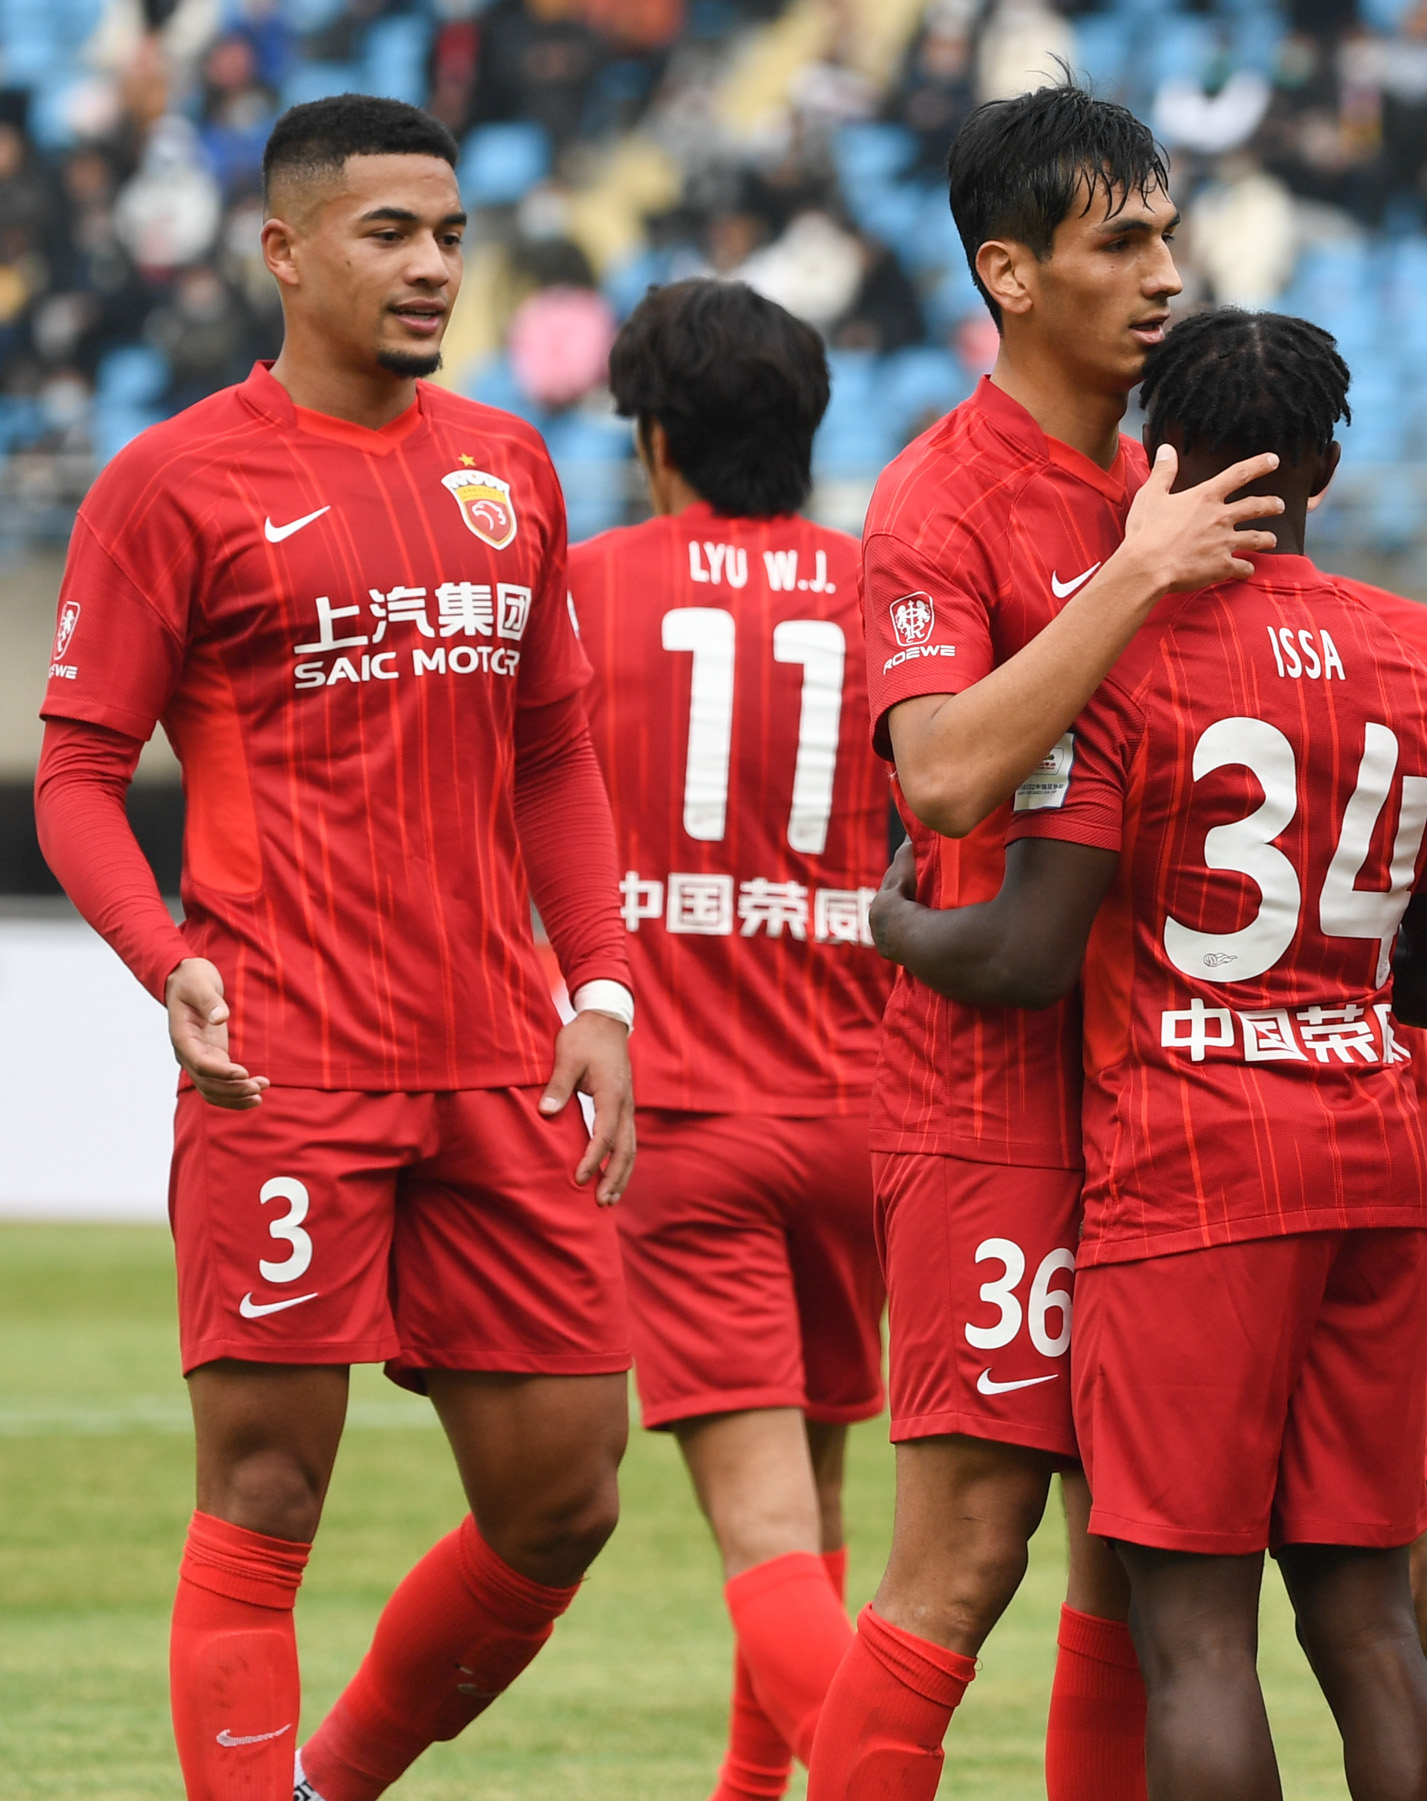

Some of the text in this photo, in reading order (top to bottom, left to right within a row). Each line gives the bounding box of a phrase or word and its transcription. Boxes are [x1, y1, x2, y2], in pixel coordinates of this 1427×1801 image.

[688, 541, 836, 594] LYU W.J.
[294, 582, 532, 654] 上汽集团
[1267, 626, 1346, 680] ISSA
[294, 646, 520, 689] SAIC MOTOR
[883, 645, 955, 675] ROEWE
[662, 607, 846, 855] 11
[619, 871, 877, 947] 中国荣威
[258, 1176, 313, 1283] 3
[965, 1238, 1076, 1357] 36
